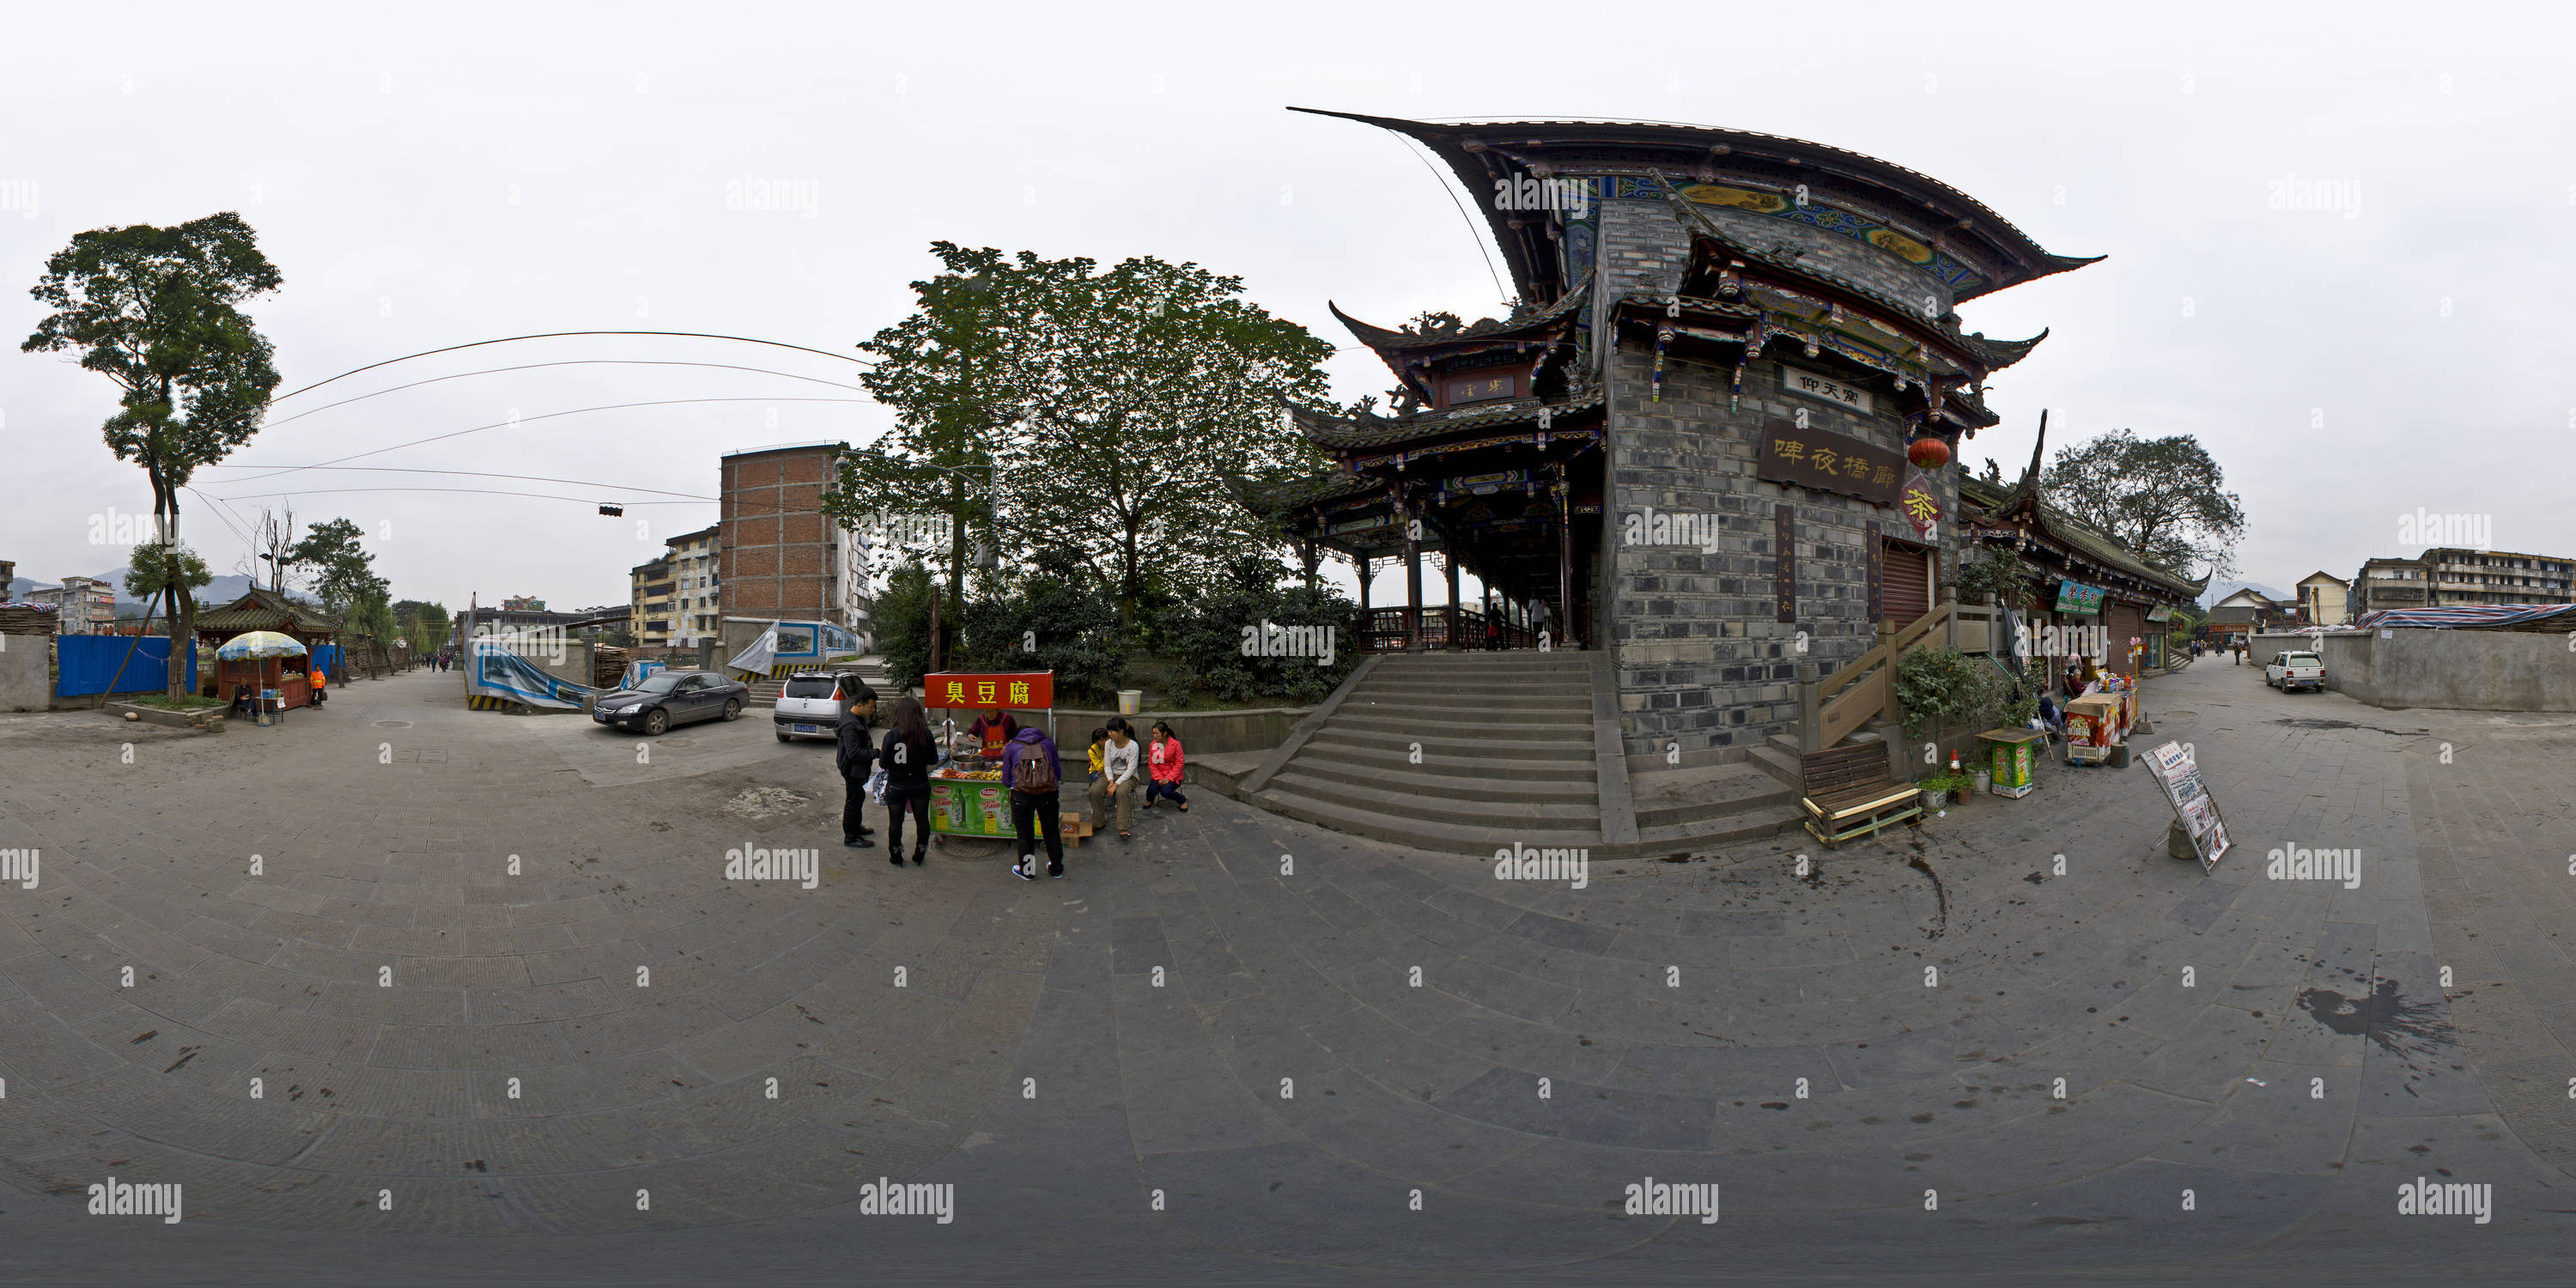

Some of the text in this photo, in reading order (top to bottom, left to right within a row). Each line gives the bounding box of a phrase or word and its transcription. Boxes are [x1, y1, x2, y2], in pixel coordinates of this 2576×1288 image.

[1903, 489, 1938, 521] 茶
[946, 680, 1030, 705] 臭豆腐
